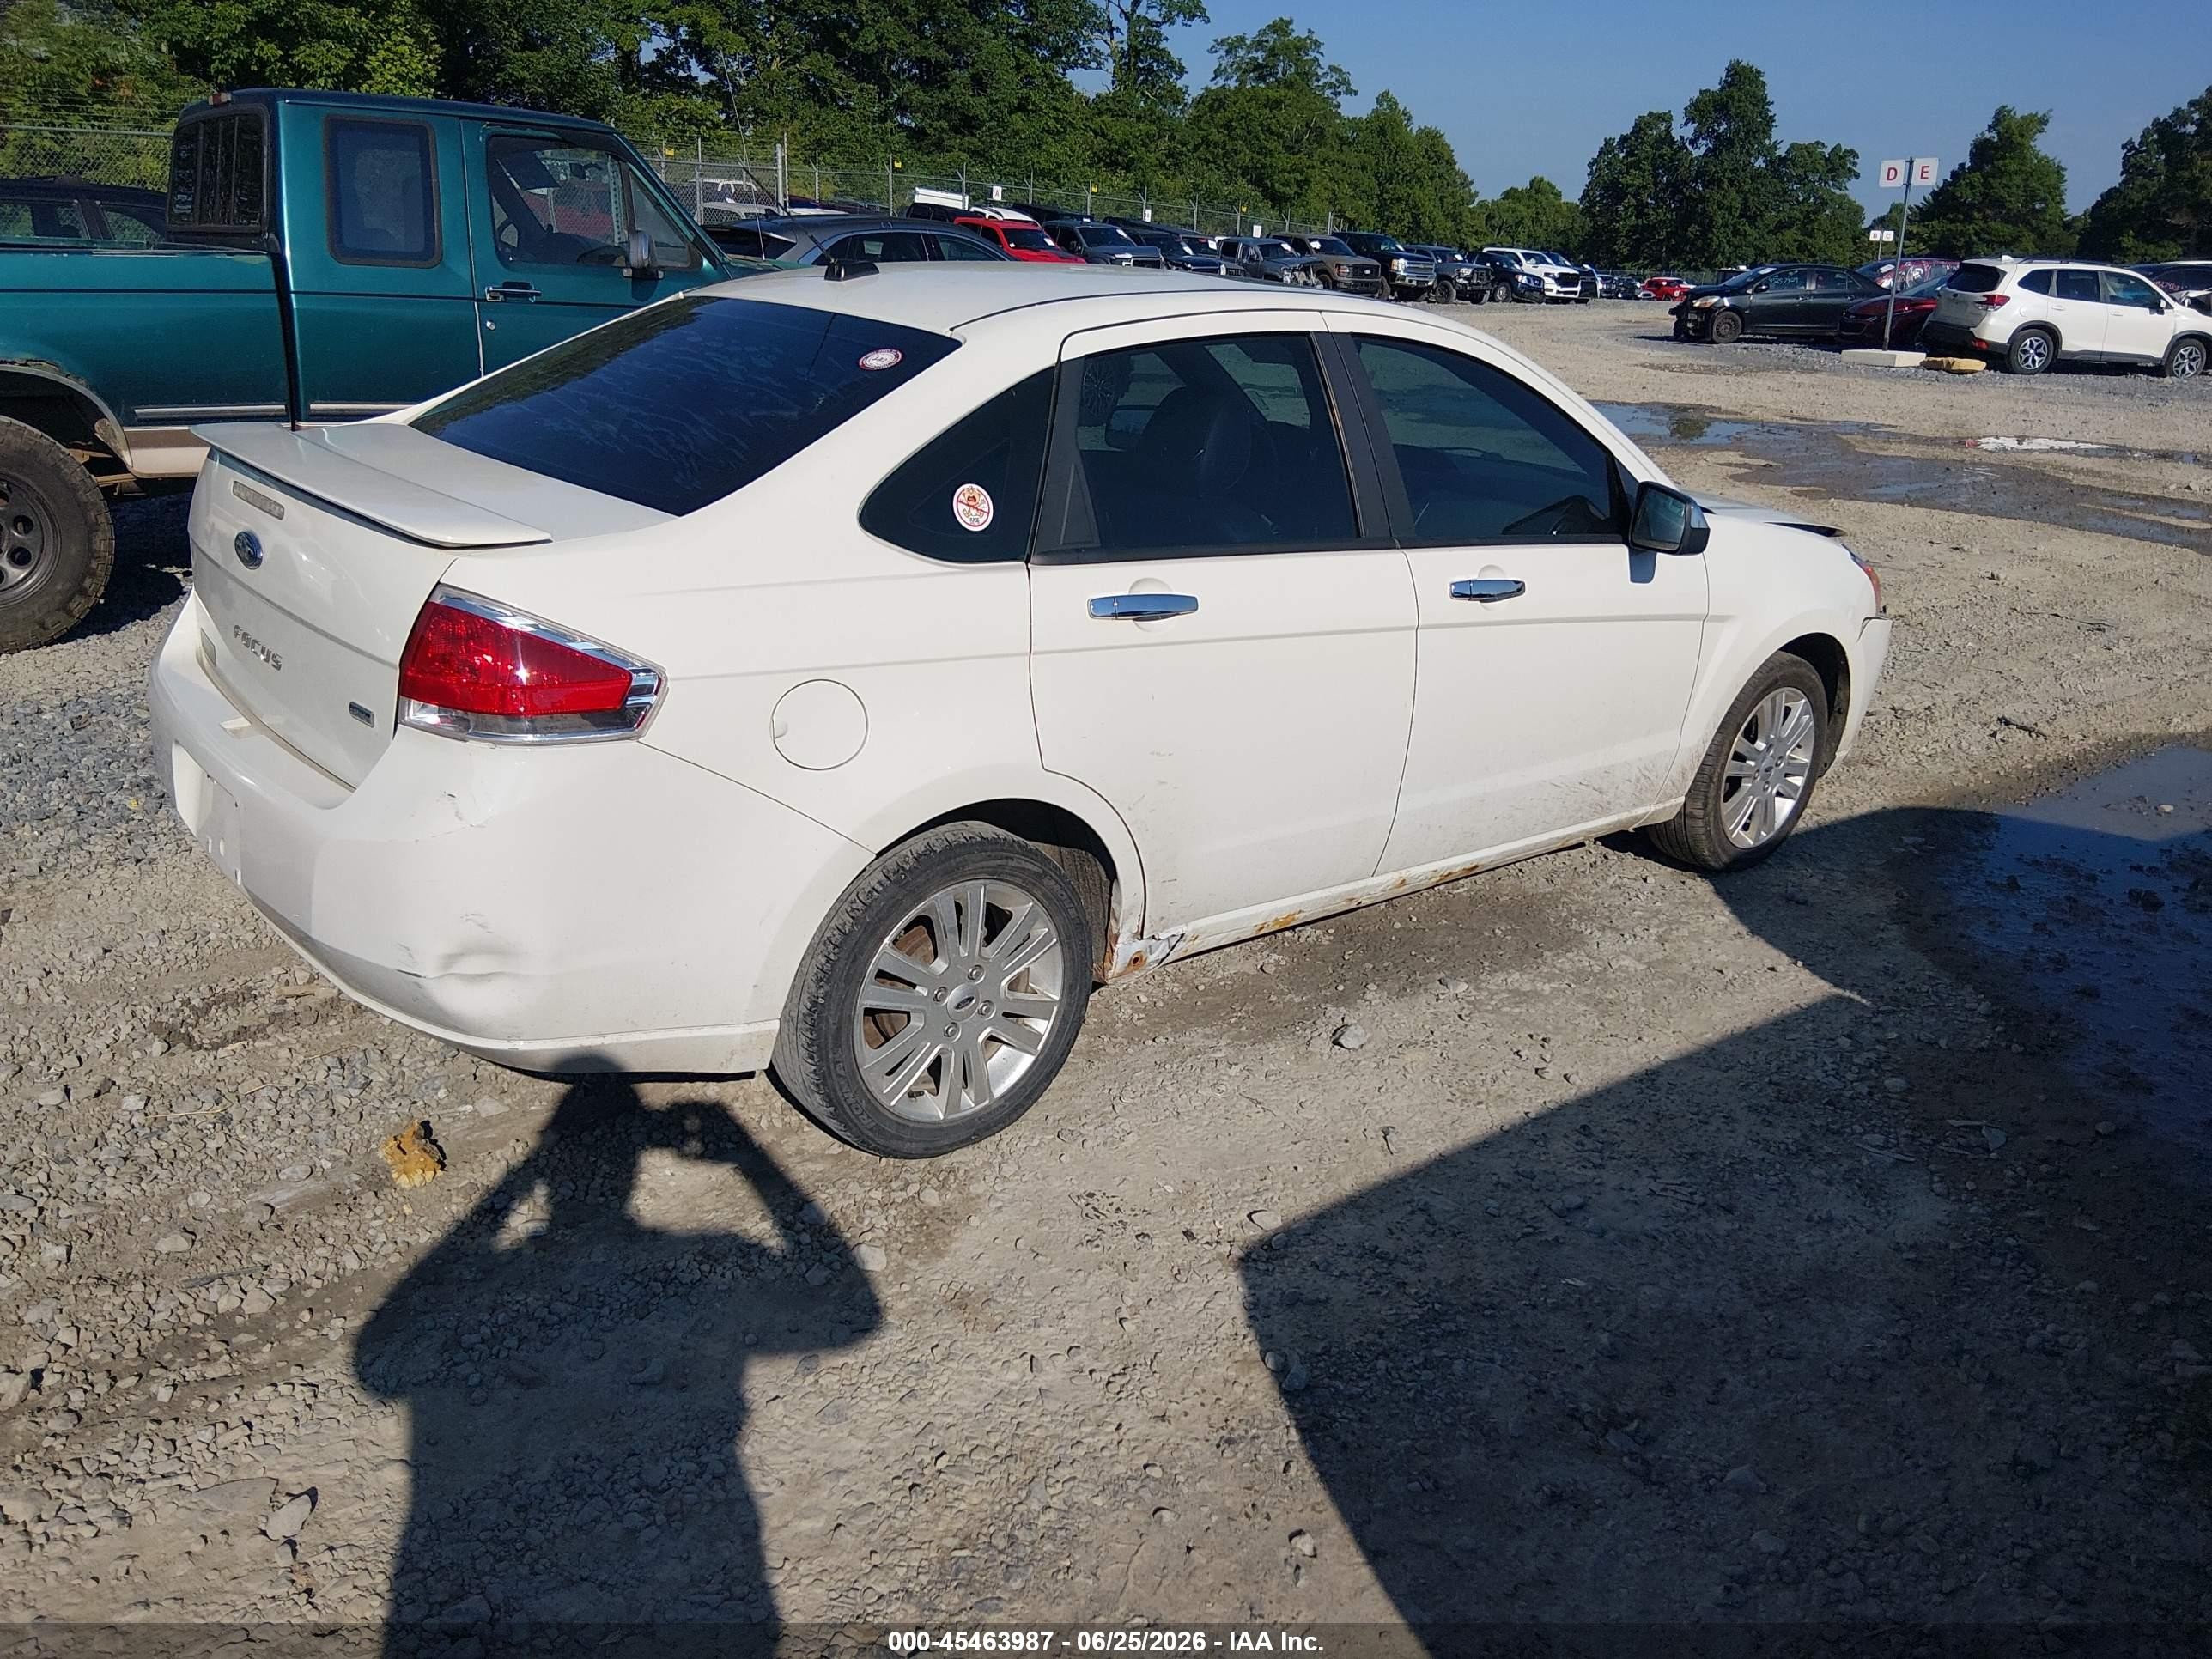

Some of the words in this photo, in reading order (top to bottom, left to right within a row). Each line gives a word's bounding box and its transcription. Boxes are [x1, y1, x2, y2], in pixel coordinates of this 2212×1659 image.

[1886, 167, 1899, 181] D
[1920, 165, 1930, 179] E
[233, 624, 283, 671] FOCUS
